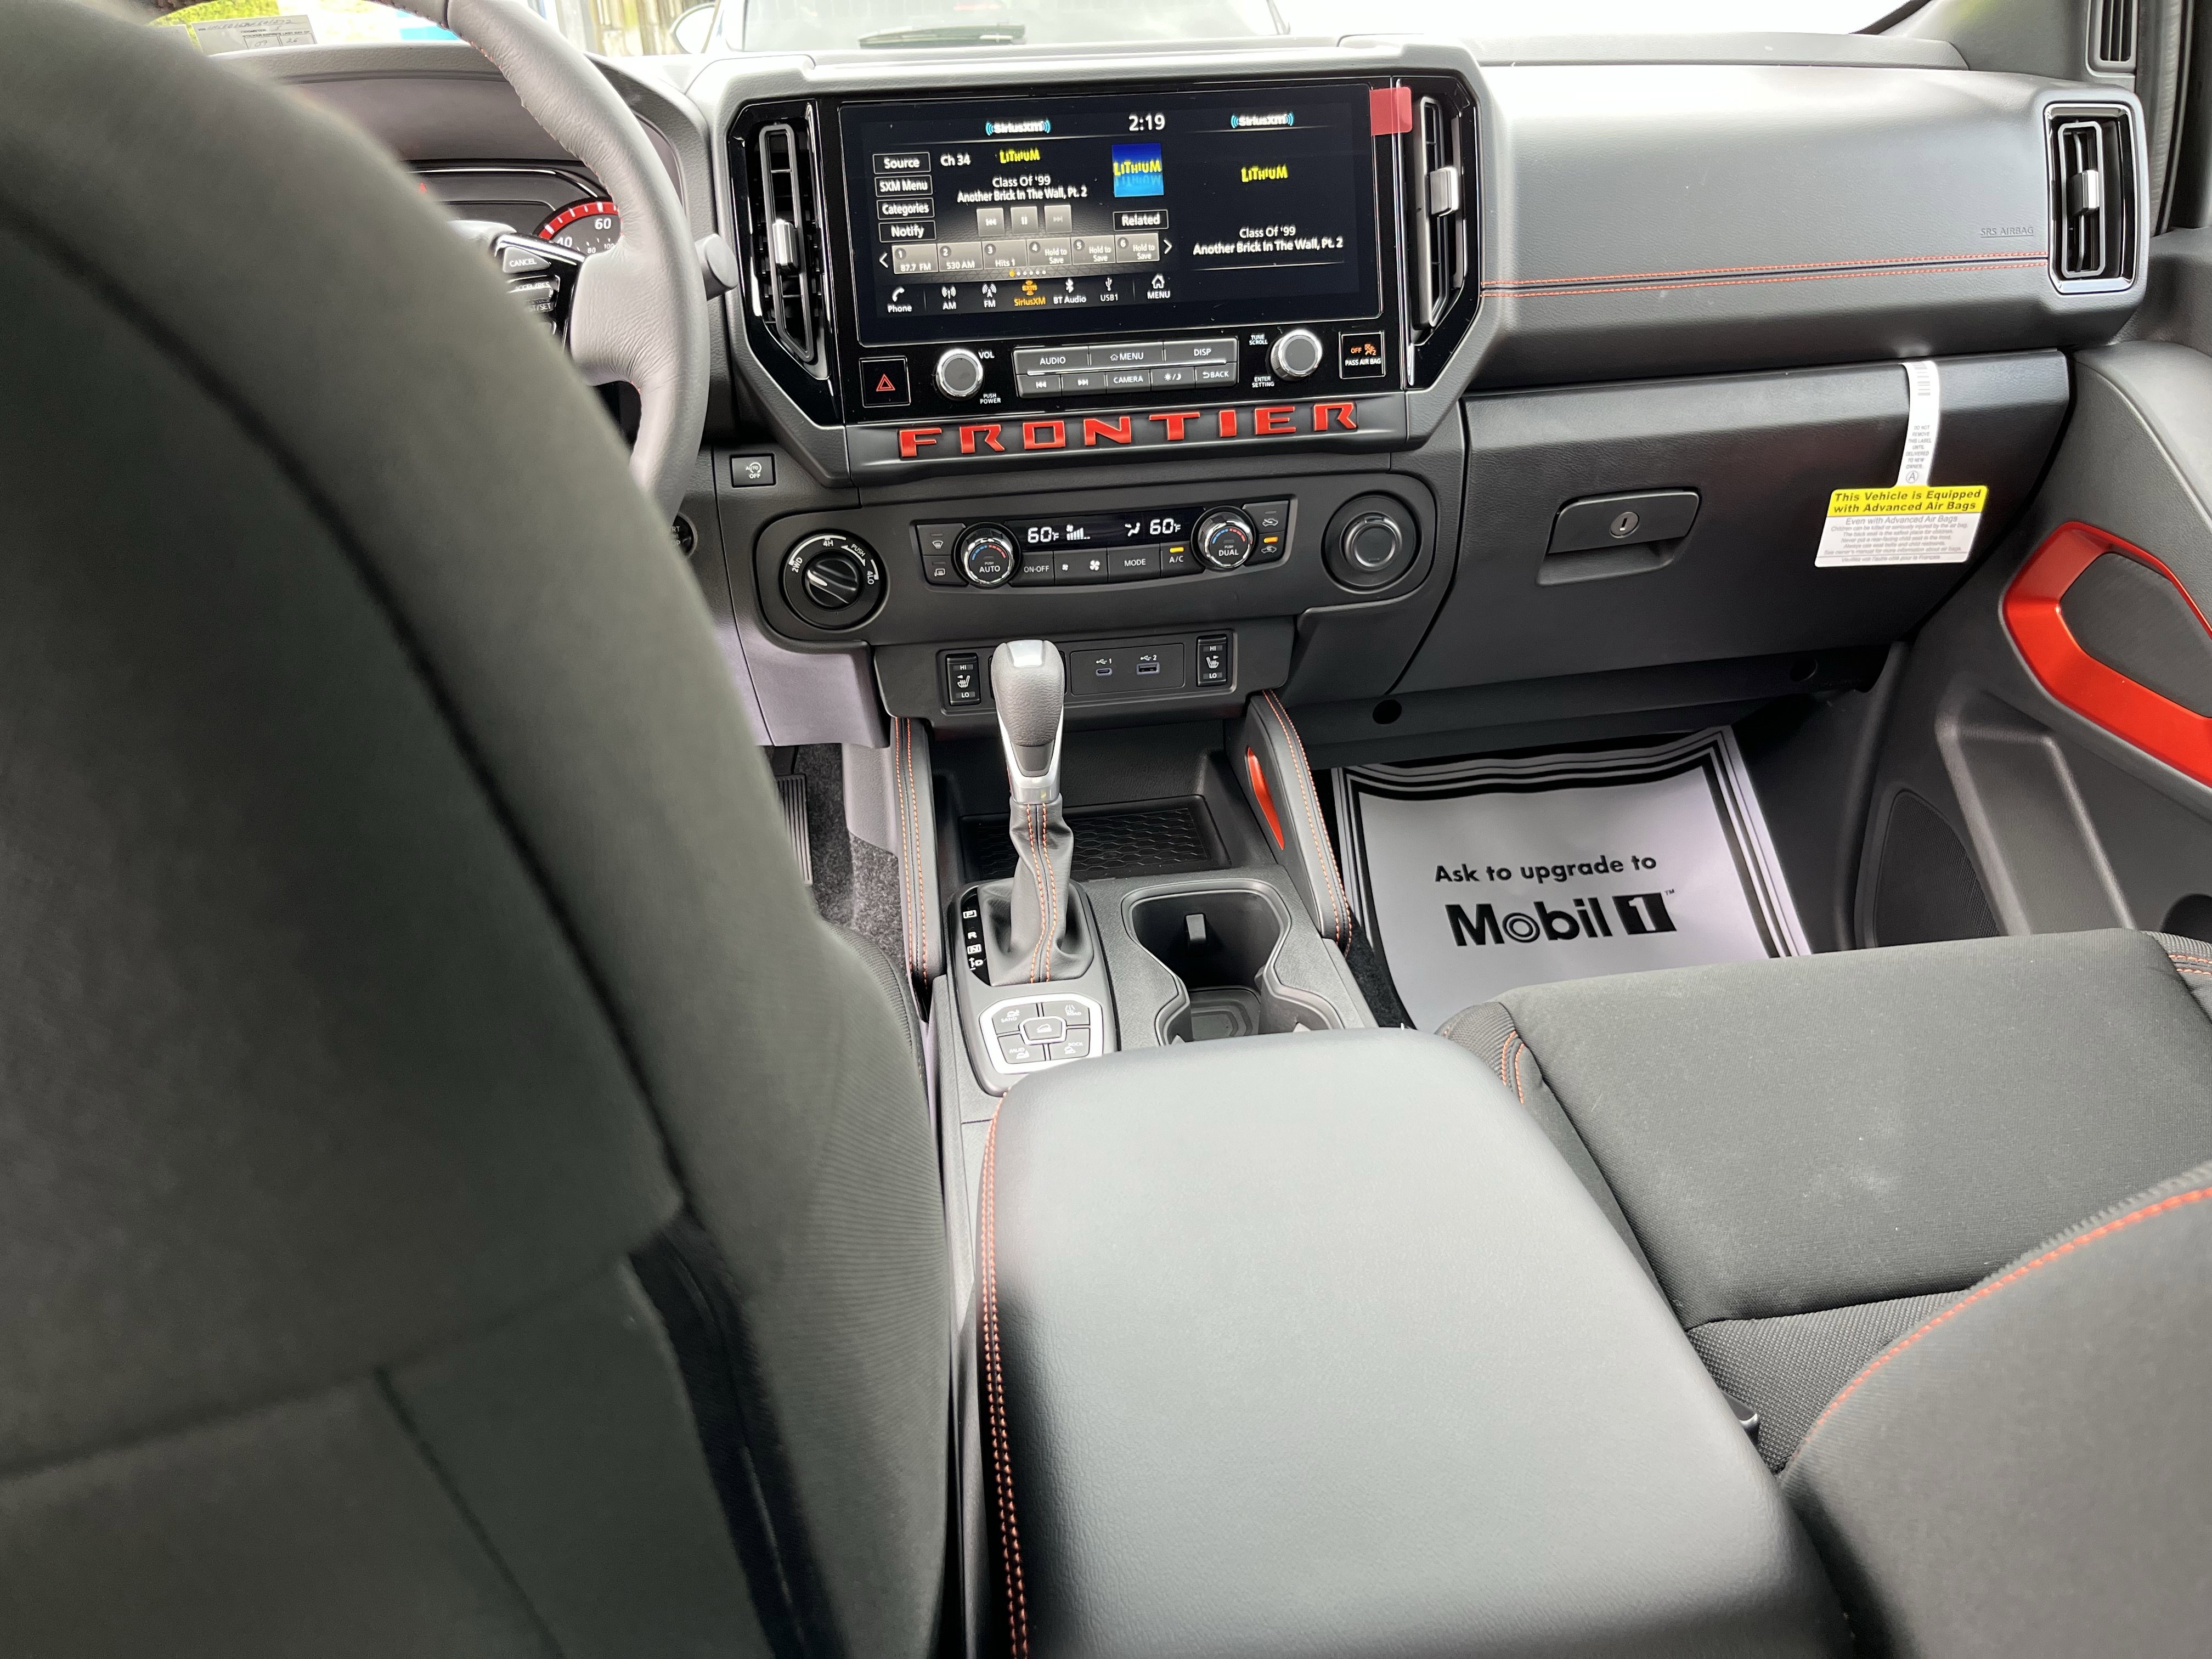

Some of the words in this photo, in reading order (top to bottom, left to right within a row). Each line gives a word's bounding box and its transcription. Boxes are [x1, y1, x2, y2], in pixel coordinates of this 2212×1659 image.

[1128, 114, 1165, 131] 2:19
[884, 157, 920, 169] Source
[940, 154, 955, 166] Ch
[957, 153, 971, 165] 34
[879, 179, 900, 192] SXM
[902, 179, 928, 191] Menu
[992, 175, 1018, 188] Class
[1019, 174, 1033, 186] Of
[1035, 174, 1051, 185] '99
[957, 190, 992, 202] Another
[994, 189, 1015, 201] Brick
[1017, 188, 1025, 200] In
[1026, 187, 1043, 199] The
[1045, 186, 1066, 199] Wall,
[1067, 185, 1080, 198] Pt.
[1081, 185, 1087, 197] 2
[882, 203, 929, 216] Categories
[595, 218, 612, 230] 60
[1122, 213, 1160, 227] Related
[891, 224, 924, 238] Notify
[1239, 227, 1263, 239] Class
[1266, 225, 1278, 237] Of
[1280, 224, 1296, 236] '99
[1980, 228, 1996, 236] SRS
[2000, 227, 2034, 235] AIRBAG
[988, 246, 993, 254] 3
[1032, 244, 1037, 252] 4
[1193, 243, 1235, 256] Another
[1237, 241, 1261, 253] Brick
[1263, 240, 1273, 252] In
[1274, 239, 1293, 251] The
[1295, 238, 1320, 251] Wall,
[1322, 236, 1334, 249] Pt.
[1336, 236, 1343, 248] 2
[898, 250, 903, 258] 1
[509, 258, 537, 267] CANCEL
[1053, 296, 1063, 304] BT
[1064, 295, 1087, 303] Audio
[1101, 294, 1118, 302] USB1
[1147, 291, 1171, 299] MENU
[1014, 297, 1046, 306] SiriusXM
[888, 304, 912, 313] Phone
[978, 350, 995, 359] VOL
[1119, 352, 1144, 361] MENU
[1193, 348, 1211, 357] DISP
[1040, 357, 1066, 365] AUDIO
[1113, 375, 1143, 383] CAMERA
[1211, 370, 1229, 379] BACK
[899, 402, 1357, 458] FRONTIER
[1835, 493, 1859, 502] This
[1865, 492, 1908, 501] Vehicle
[1911, 490, 1922, 499] is
[1926, 489, 1982, 500] Equipped
[1834, 504, 1859, 513] with
[1863, 502, 1922, 512] Advanced
[1925, 501, 1943, 511] Air
[1946, 501, 1976, 511] Bags
[1884, 516, 1923, 524] Advanced
[1938, 515, 1958, 524] Bags
[851, 544, 866, 557] PUSH
[1124, 558, 1146, 567] MODE
[1169, 556, 1184, 564] A/C
[792, 557, 803, 573] 2WD
[979, 565, 1001, 573] AUTO
[1435, 864, 1480, 883] Ask
[1486, 865, 1512, 881] to
[1520, 855, 1624, 884] upgrade
[1631, 855, 1657, 871] to
[1444, 896, 1613, 947] Mobil
